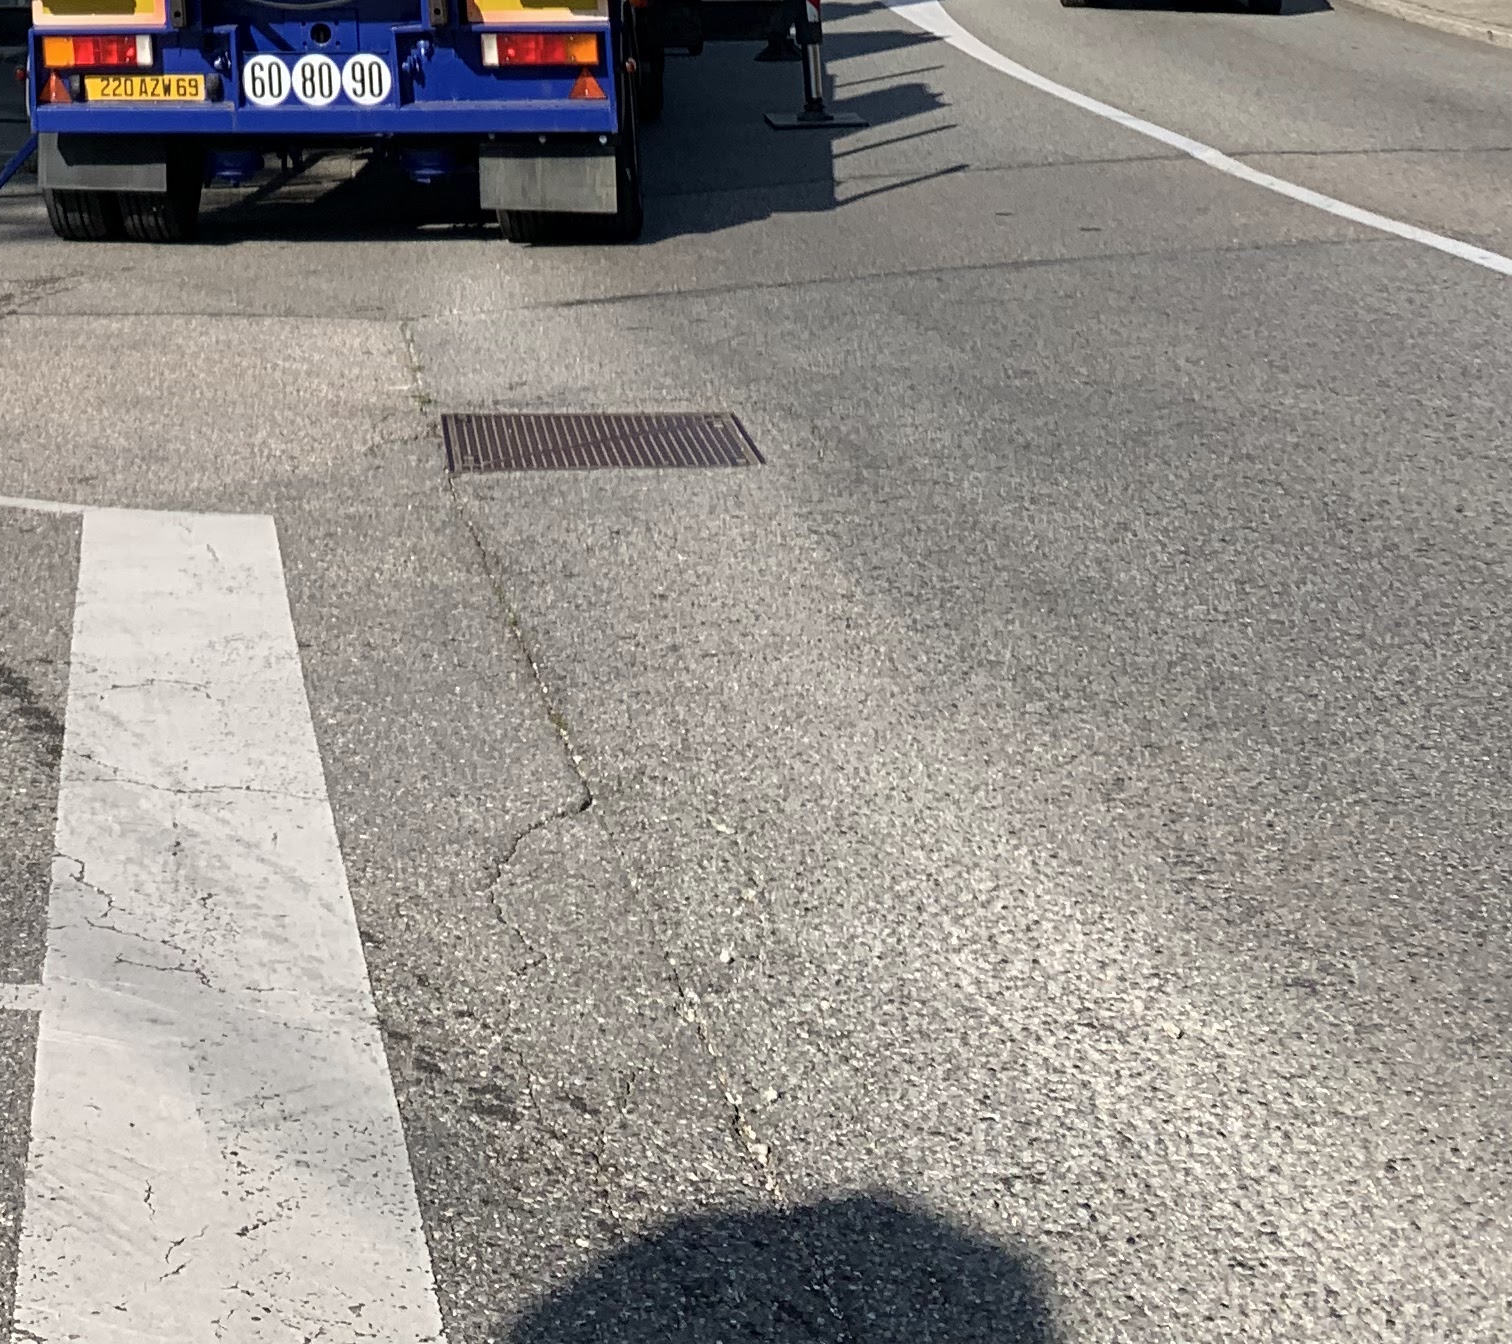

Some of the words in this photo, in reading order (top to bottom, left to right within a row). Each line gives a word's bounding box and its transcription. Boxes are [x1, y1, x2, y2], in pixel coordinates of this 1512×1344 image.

[101, 78, 134, 97] 220
[139, 78, 171, 97] AZW
[176, 78, 199, 97] 69
[251, 61, 282, 98] 60
[301, 62, 332, 98] 80
[351, 61, 383, 98] 90
